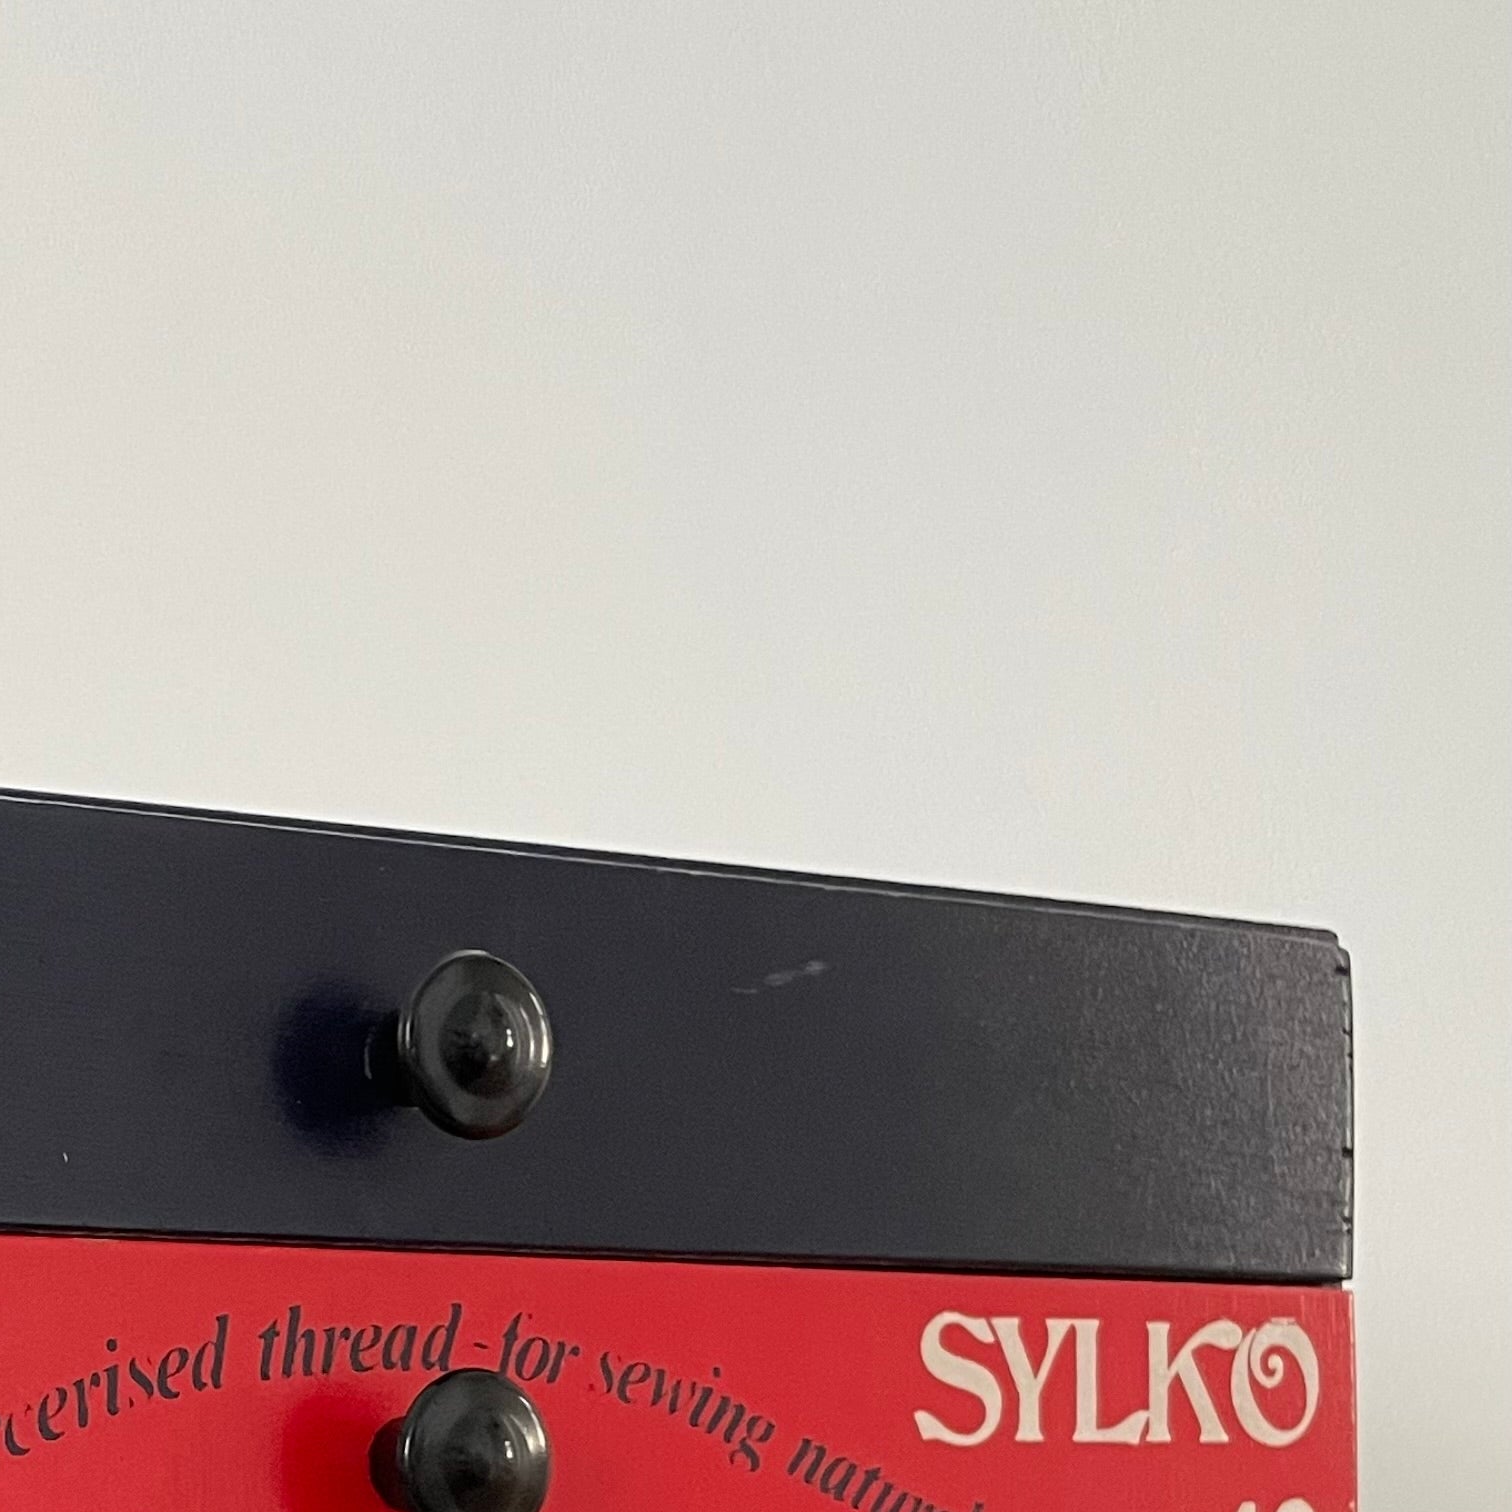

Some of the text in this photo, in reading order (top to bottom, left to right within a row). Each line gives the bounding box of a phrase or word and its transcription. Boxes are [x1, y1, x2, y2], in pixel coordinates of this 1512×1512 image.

[258, 1303, 462, 1381] thread
[494, 1312, 580, 1384] for
[589, 1351, 776, 1472] sewing
[914, 1311, 1319, 1447] SYLKO
